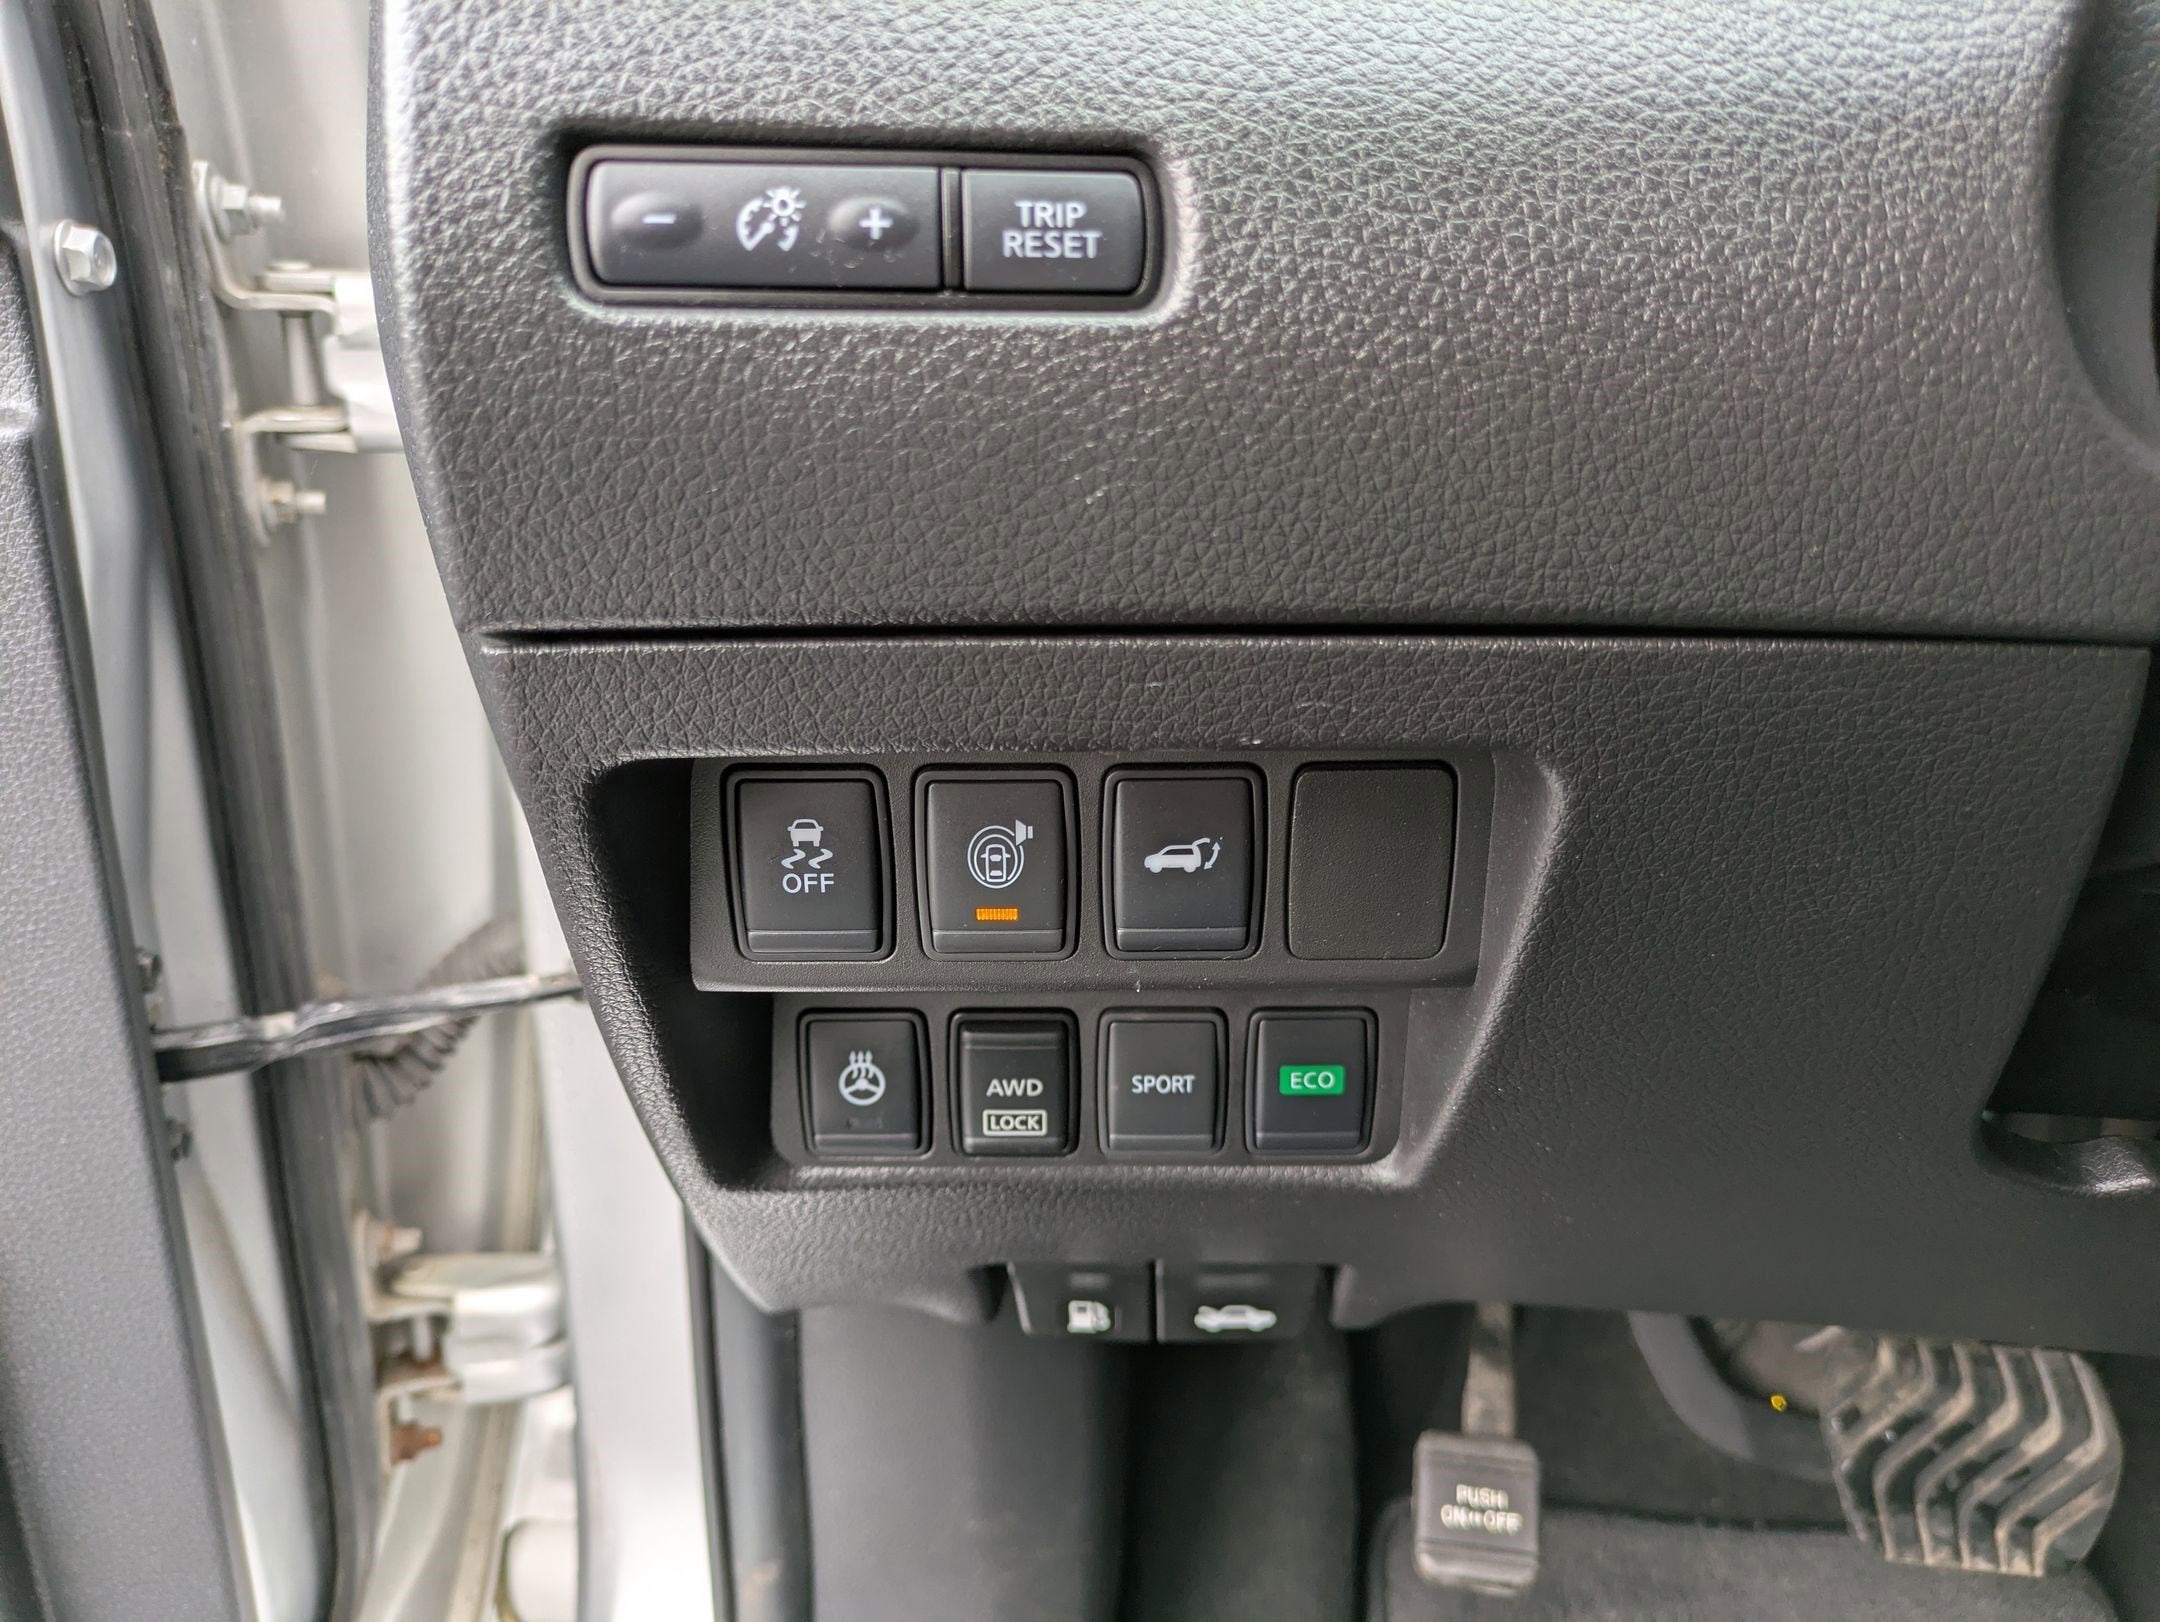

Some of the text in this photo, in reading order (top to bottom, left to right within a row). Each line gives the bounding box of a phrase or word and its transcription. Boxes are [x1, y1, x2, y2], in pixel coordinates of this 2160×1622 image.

[1014, 200, 1087, 228] TRIP
[1002, 230, 1101, 259] RESET
[781, 872, 835, 894] OFF
[986, 1078, 1044, 1097] AWD
[1131, 1073, 1196, 1095] SPORT
[1289, 1071, 1336, 1090] ECO
[989, 1114, 1041, 1132] LOCK
[1456, 1484, 1509, 1511] PUSH
